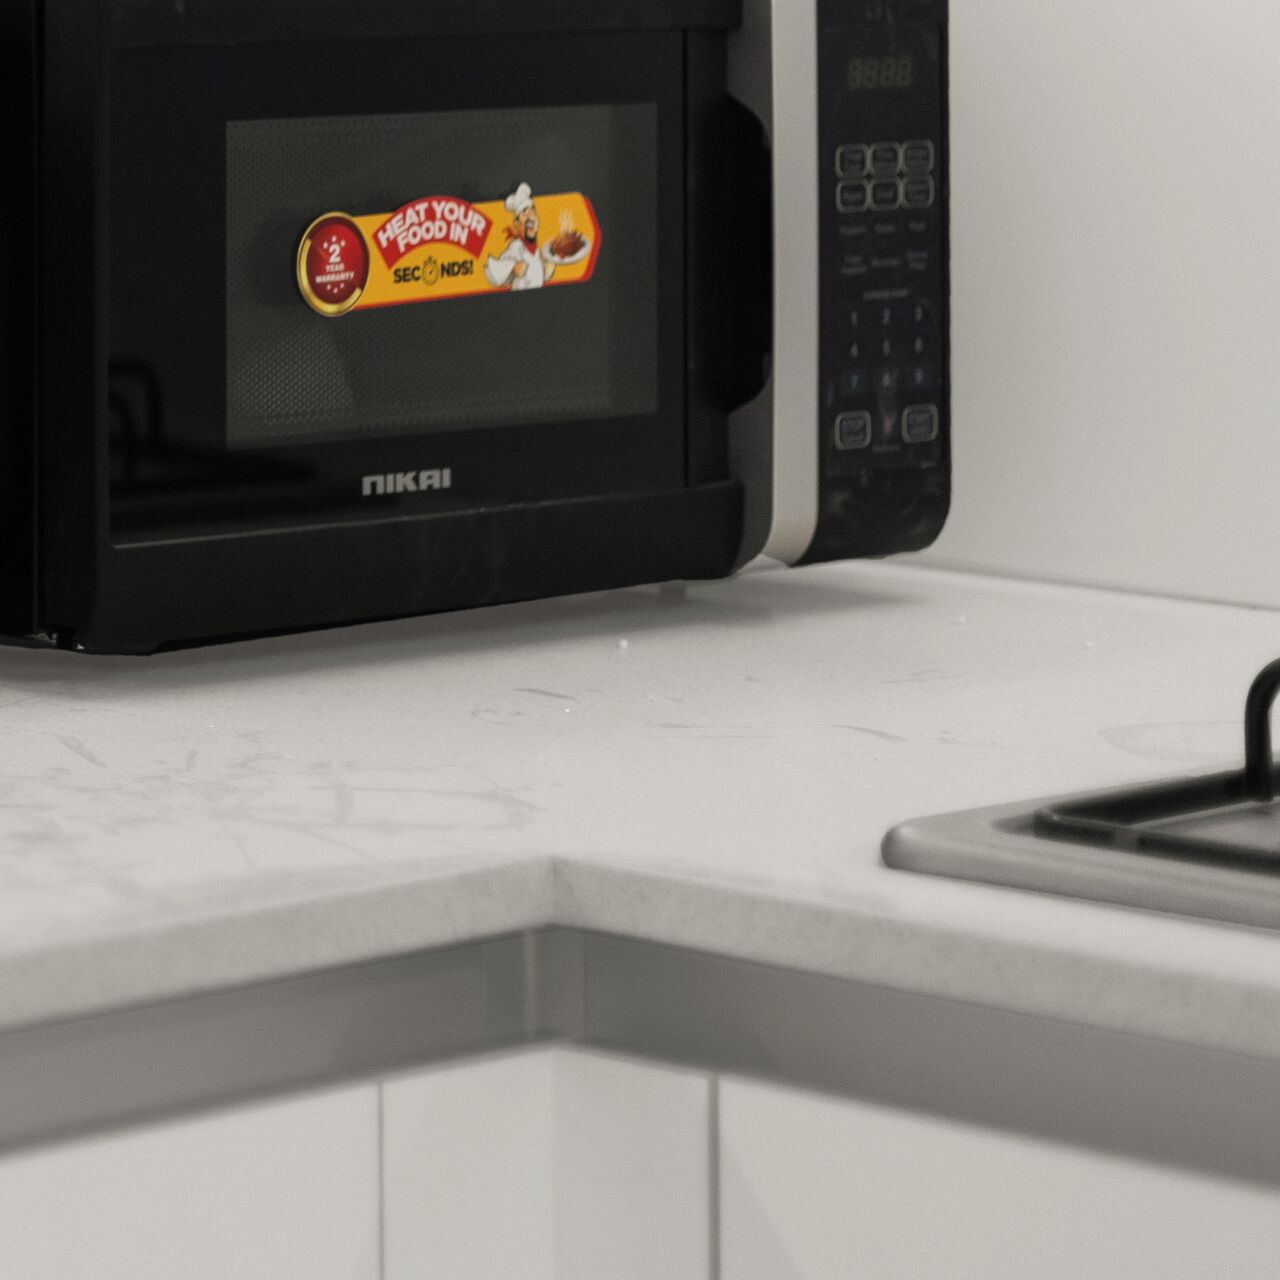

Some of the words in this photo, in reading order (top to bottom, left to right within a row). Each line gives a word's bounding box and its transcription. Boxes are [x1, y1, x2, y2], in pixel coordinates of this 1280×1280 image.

[378, 202, 429, 249] HEAT
[431, 200, 487, 237] YOUR
[397, 220, 447, 253] FOOD
[449, 222, 469, 246] IN
[328, 242, 342, 264] 2
[362, 468, 451, 496] NIKAI
